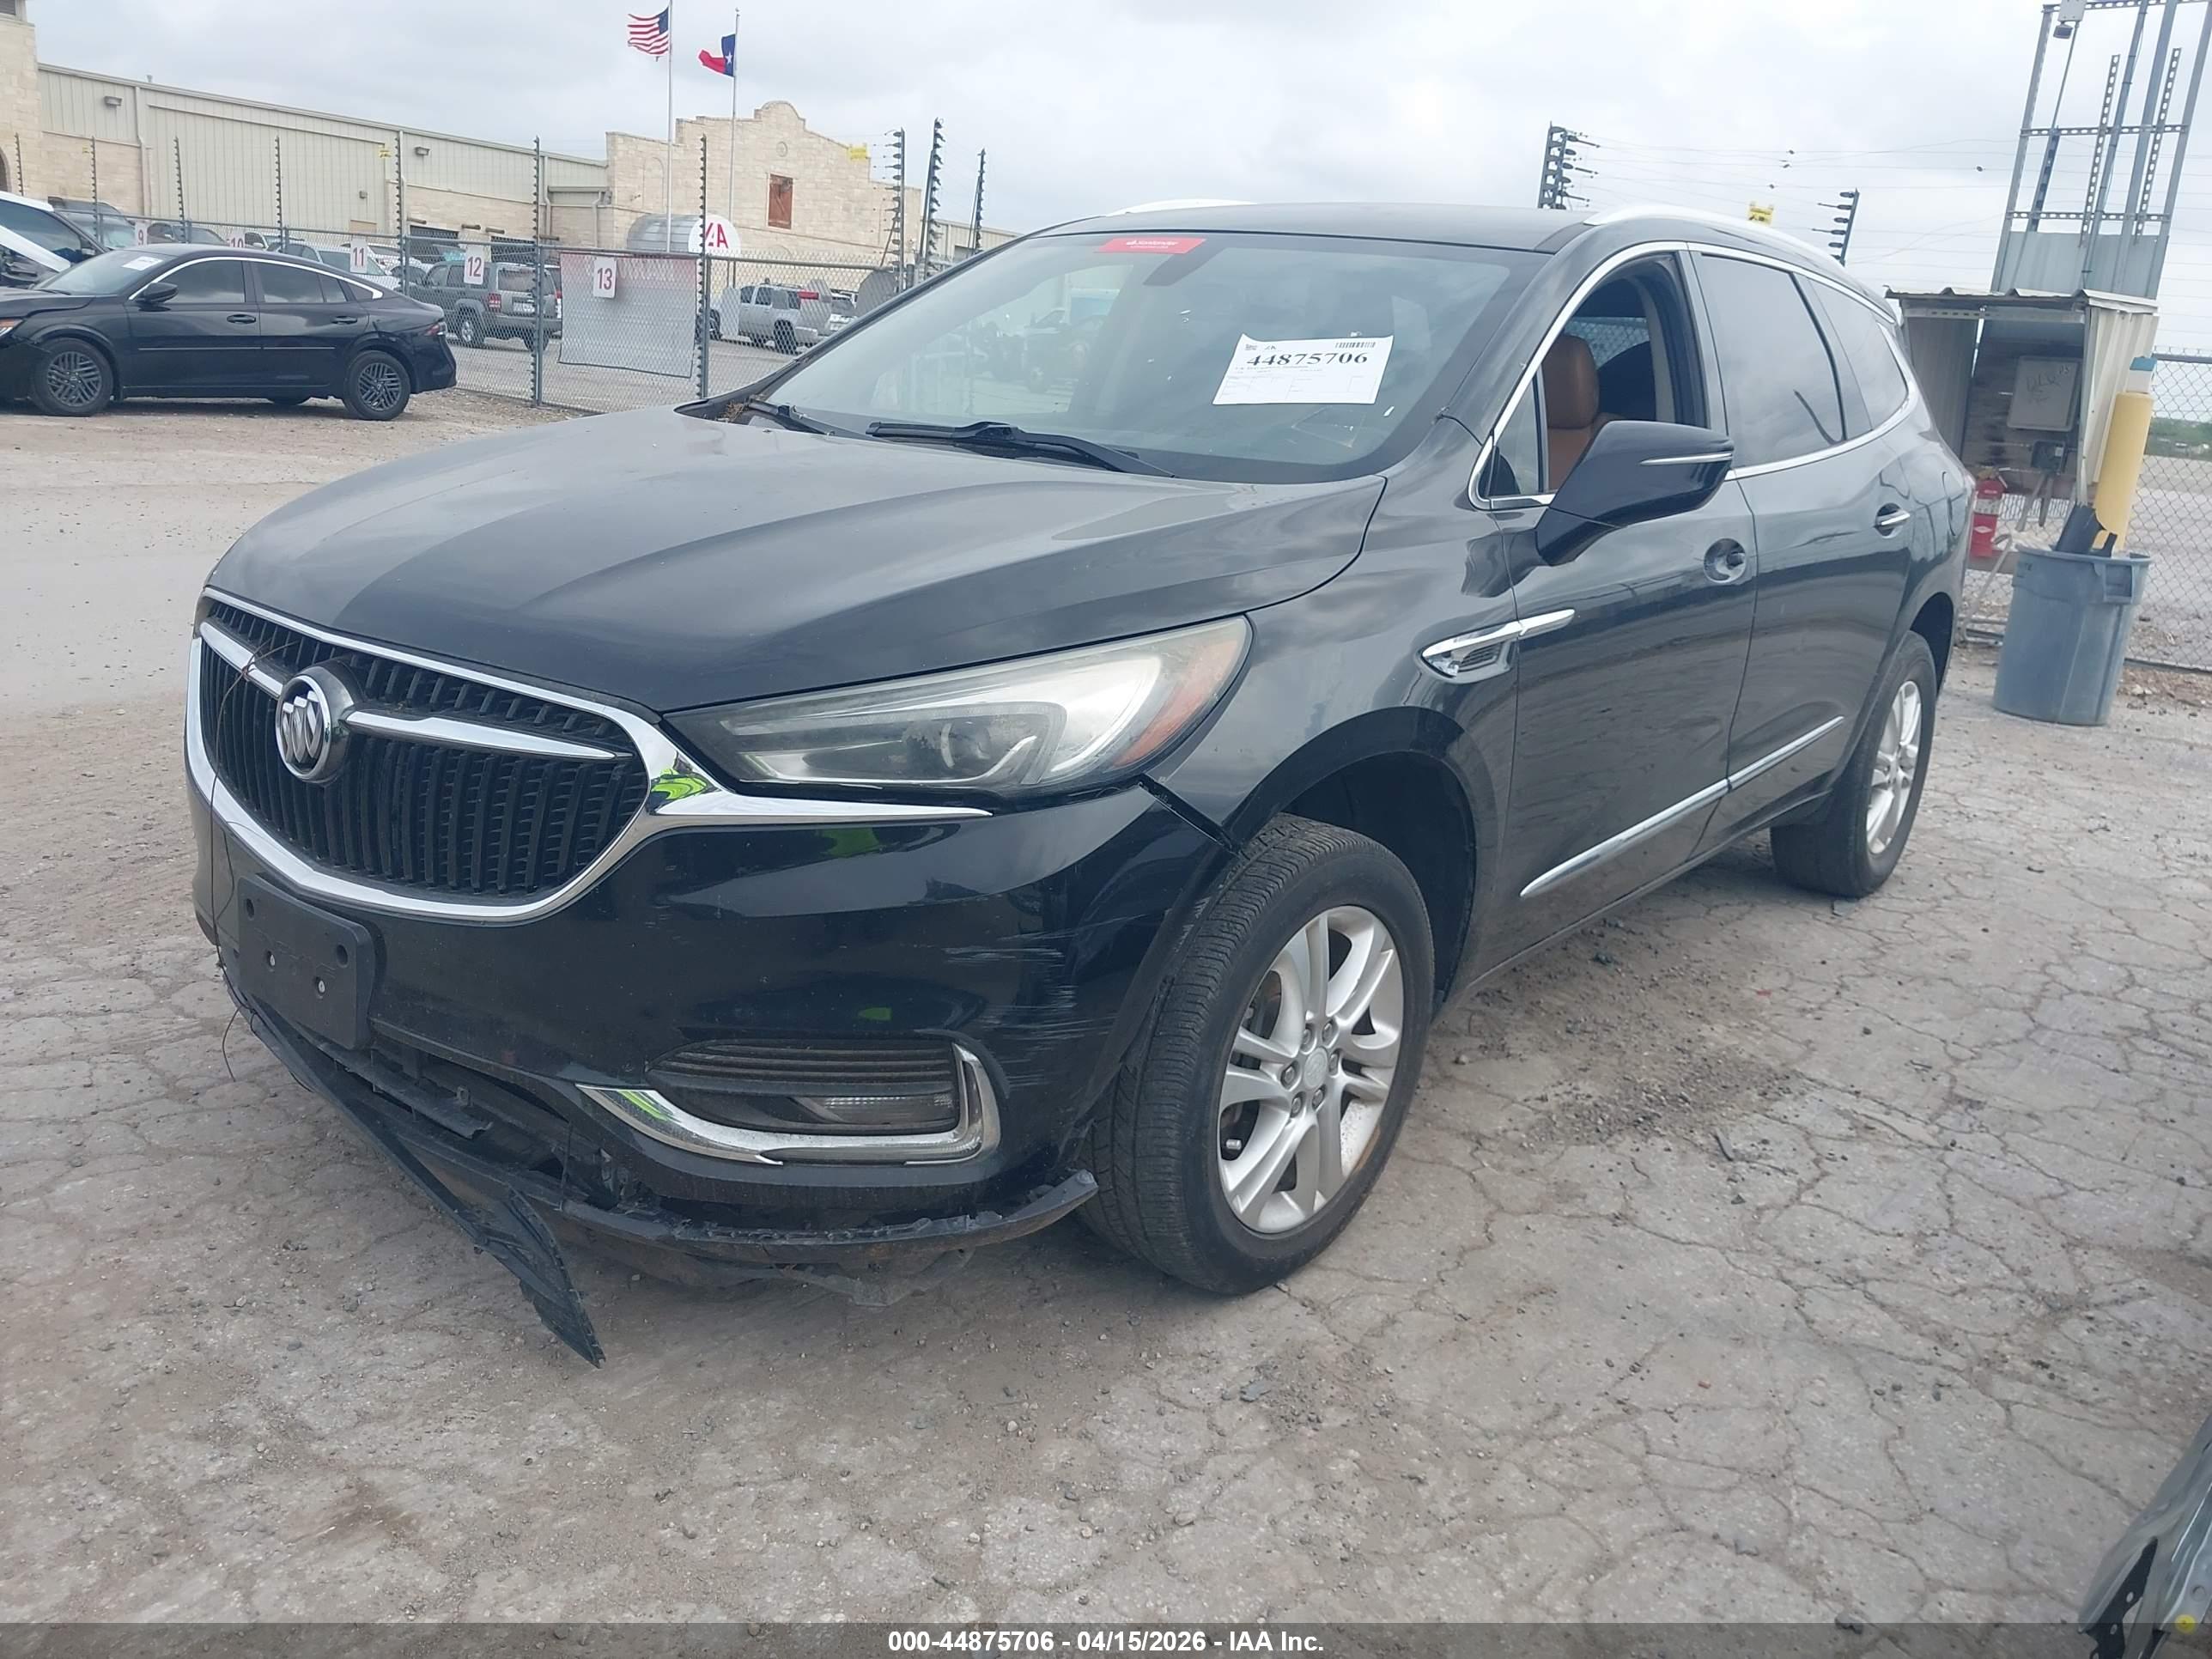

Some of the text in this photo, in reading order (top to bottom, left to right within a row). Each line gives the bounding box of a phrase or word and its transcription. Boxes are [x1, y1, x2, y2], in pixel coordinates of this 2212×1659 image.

[138, 229, 144, 246] 9
[353, 247, 365, 267] 11
[467, 256, 482, 277] 12
[597, 267, 613, 290] 13
[1246, 352, 1368, 367] 44875706
